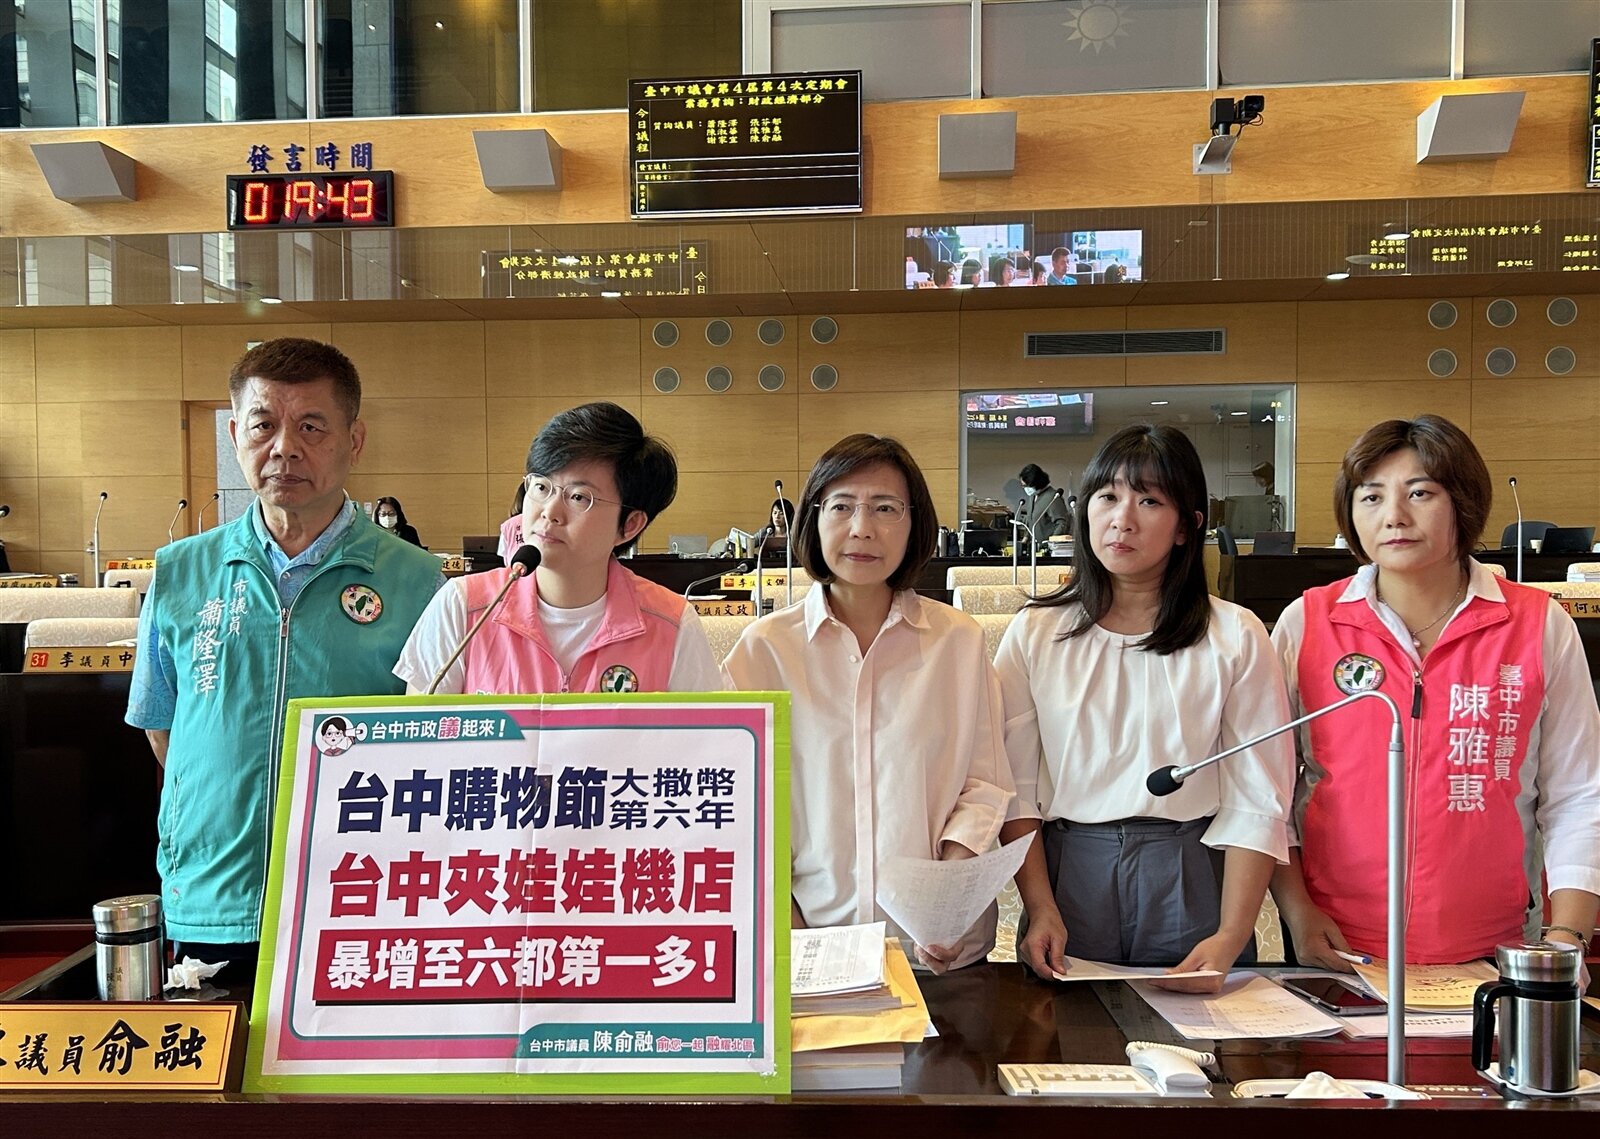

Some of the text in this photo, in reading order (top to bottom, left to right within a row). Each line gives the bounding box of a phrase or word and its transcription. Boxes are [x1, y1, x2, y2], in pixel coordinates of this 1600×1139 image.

[644, 78, 848, 97] 臺中市議會第4屆第4次定期會
[635, 108, 650, 154] 今日議程
[246, 141, 373, 173] 發言時間
[228, 579, 249, 636] 市議員
[31, 653, 48, 667] 31
[192, 597, 226, 696] 蕭隆澤
[1494, 664, 1523, 781] 臺中市議員
[1447, 683, 1490, 813] 陳雅惠
[336, 767, 607, 833] 台中購物節
[610, 767, 735, 798] 大撒幣
[609, 800, 735, 830] 第六年
[329, 847, 734, 918] 台中夾娃娃機店
[529, 1039, 590, 1053] 台中市議員
[593, 1030, 654, 1053] 陳俞融
